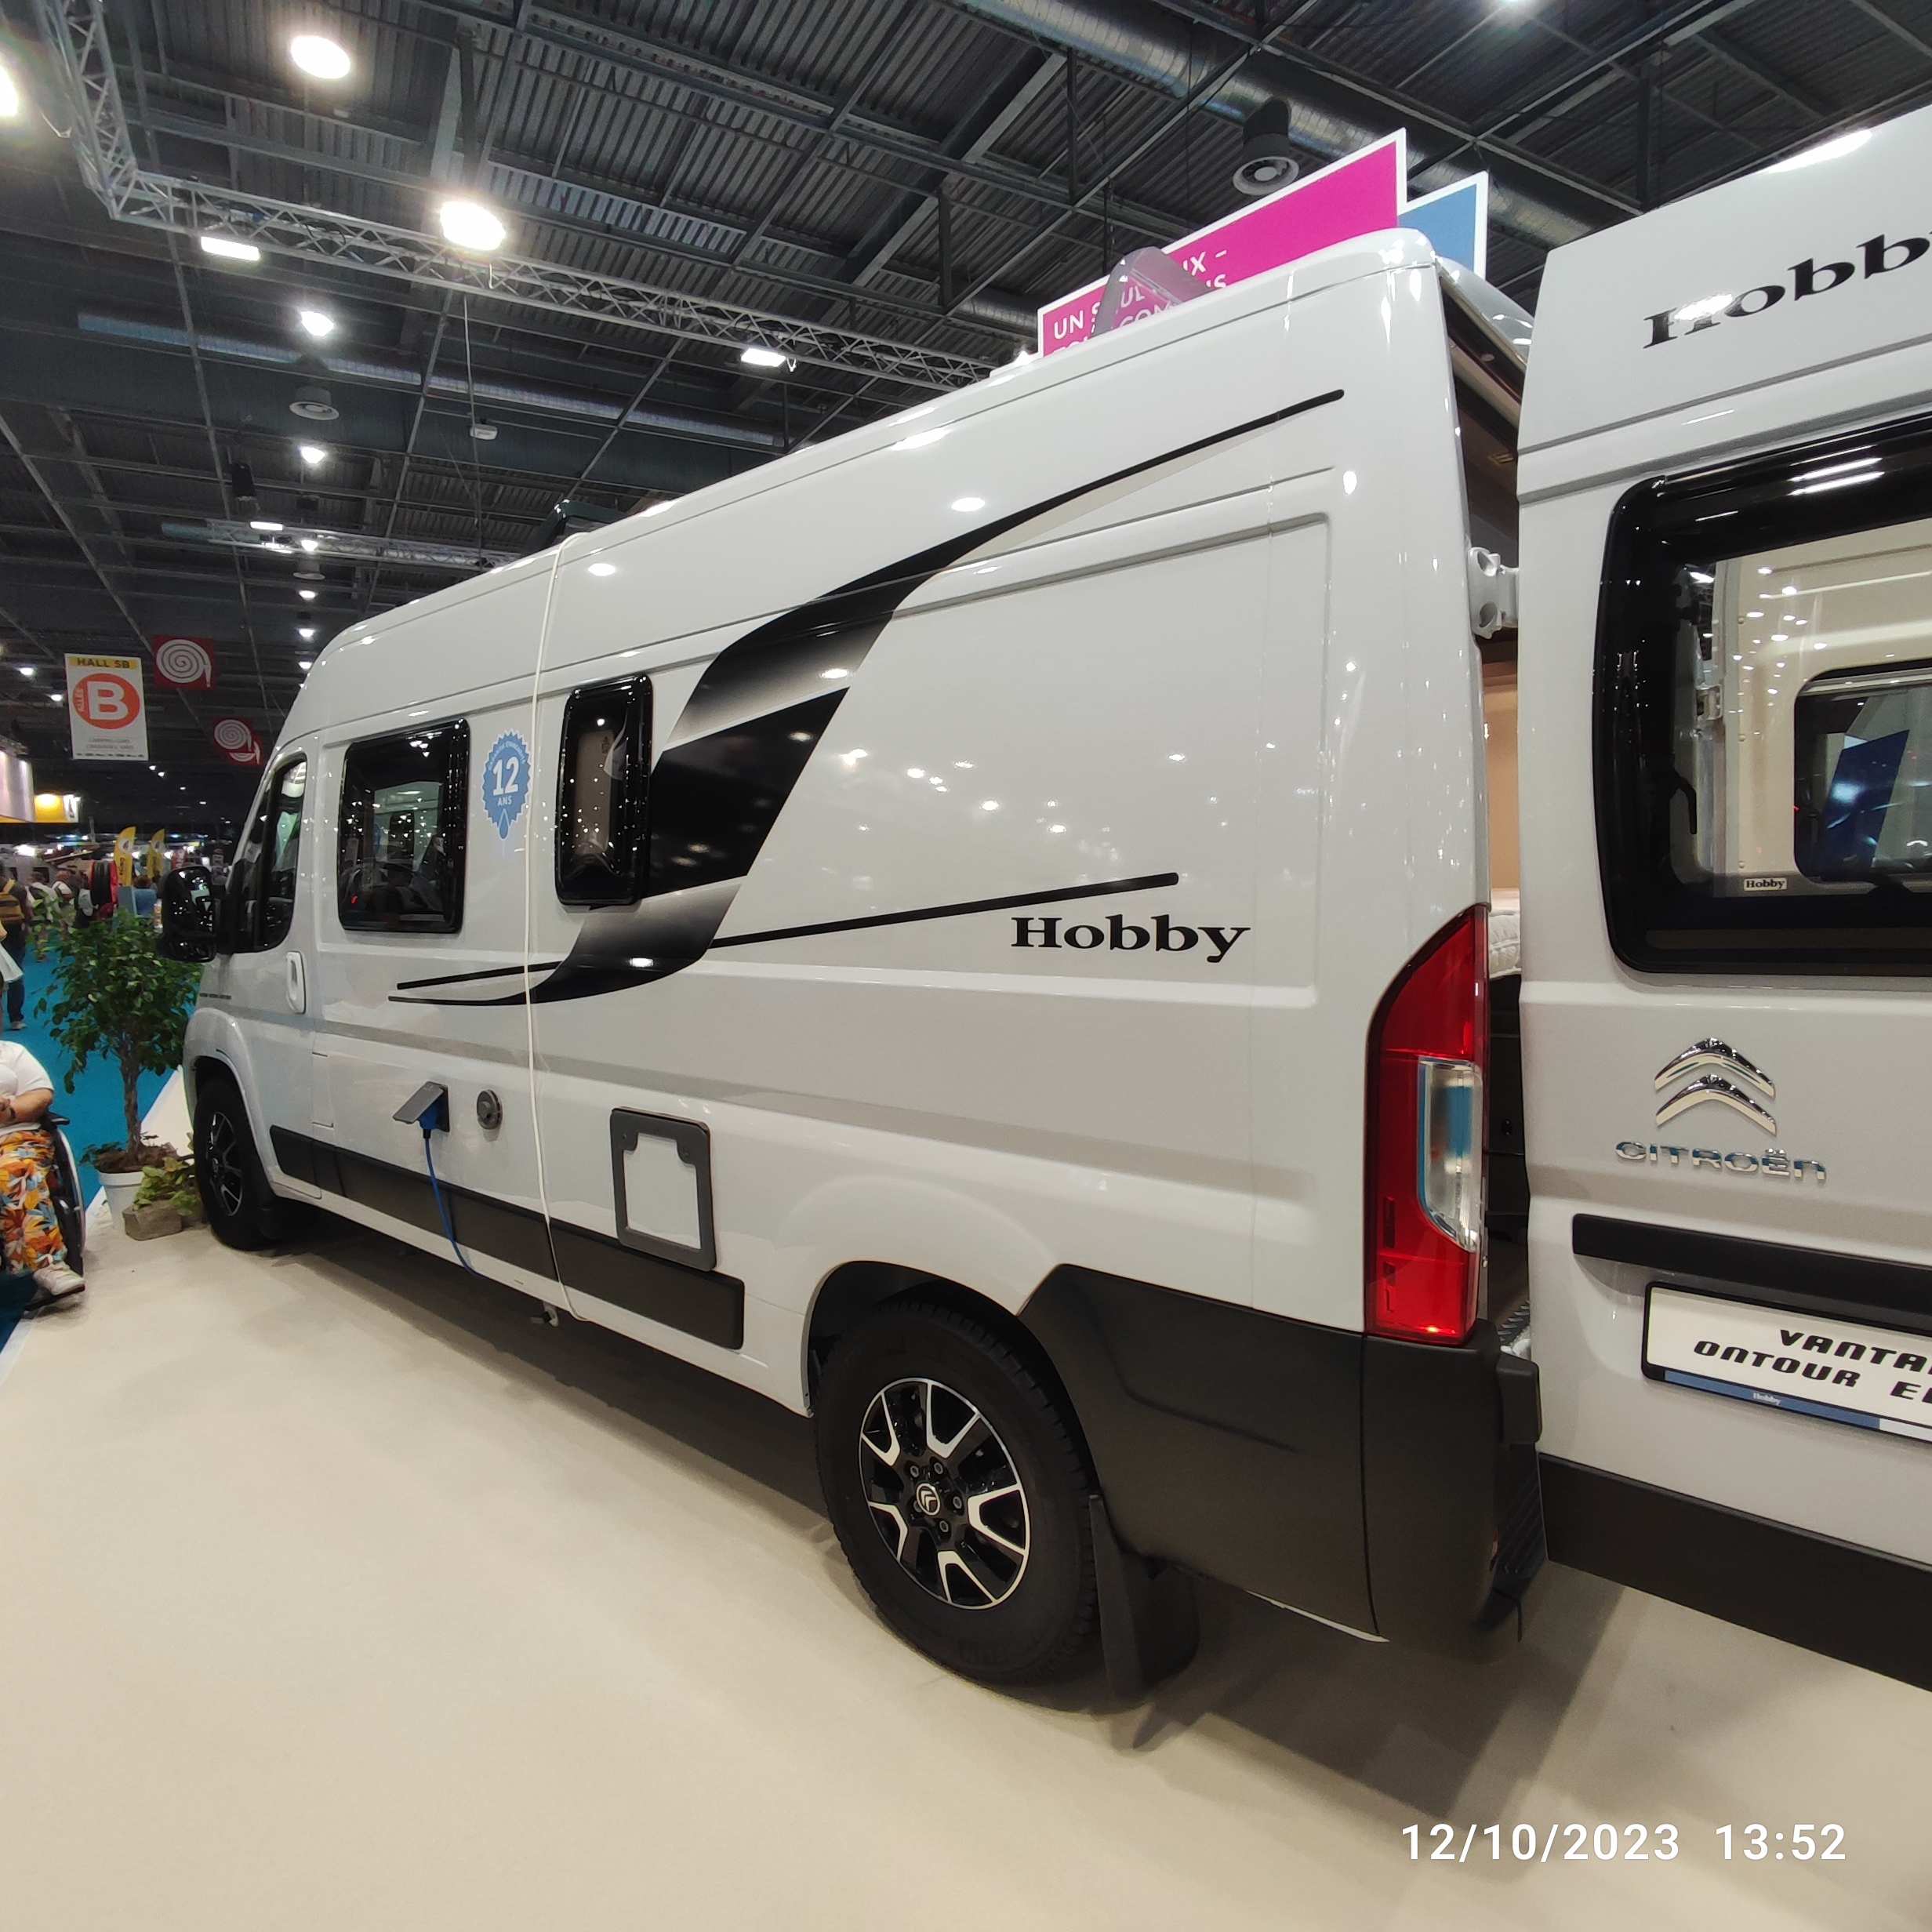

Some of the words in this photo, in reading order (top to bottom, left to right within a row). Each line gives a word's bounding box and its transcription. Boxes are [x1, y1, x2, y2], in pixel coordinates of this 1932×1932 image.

[1643, 231, 1932, 349] Hobb
[1054, 310, 1084, 339] UN
[77, 657, 109, 667] HALL
[87, 681, 129, 721] B
[492, 756, 520, 796] 12
[497, 795, 512, 806] ANS
[1745, 879, 1786, 889] Hobby
[1011, 914, 1251, 963] Hobby
[1694, 1341, 1861, 1387] ONTOUR
[1780, 1329, 1932, 1375] VANTA
